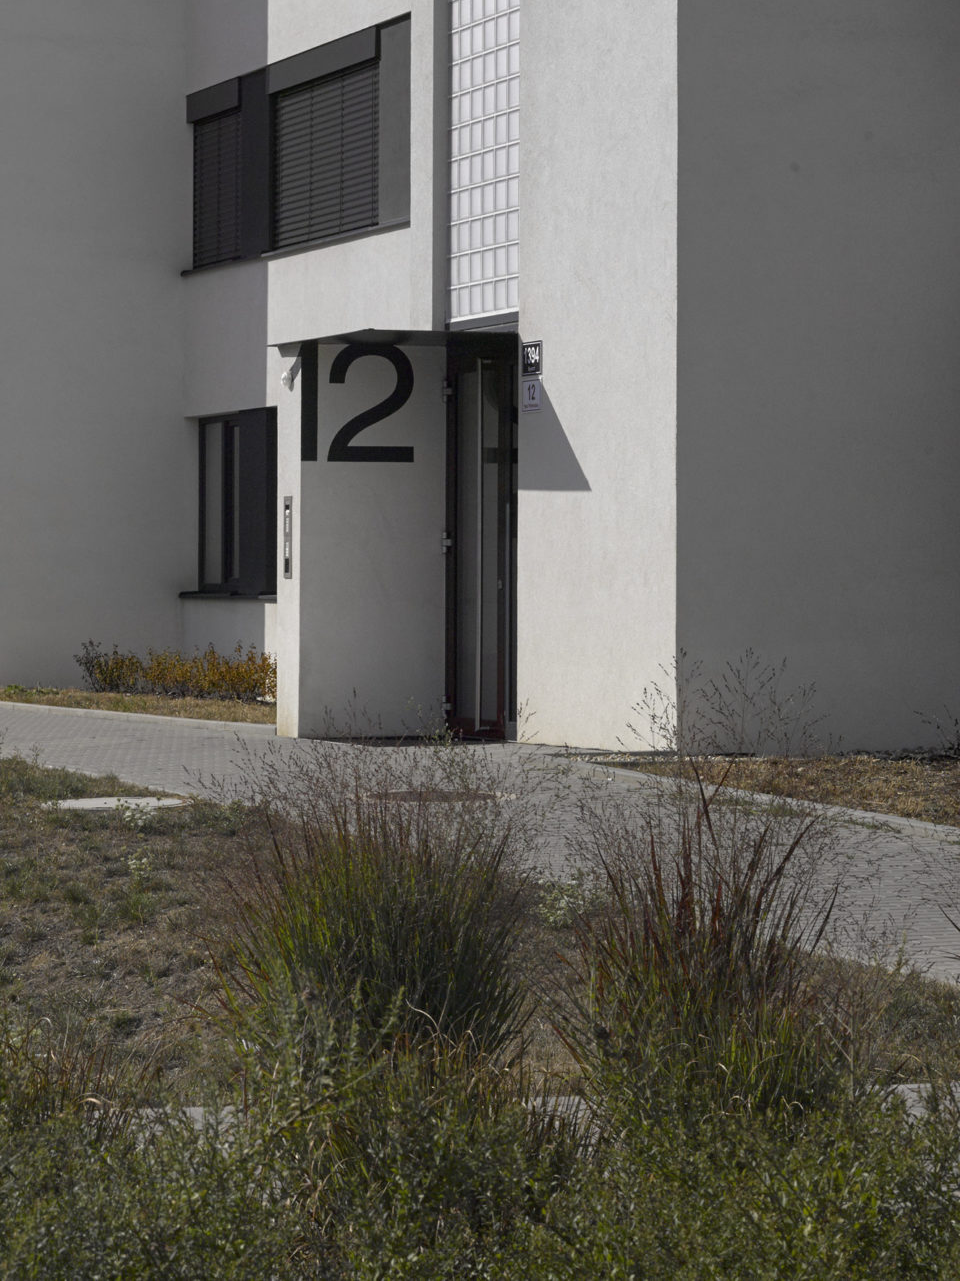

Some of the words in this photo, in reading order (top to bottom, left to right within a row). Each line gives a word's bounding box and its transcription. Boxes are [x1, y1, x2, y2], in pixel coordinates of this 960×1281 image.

[524, 346, 540, 364] 1394
[300, 340, 414, 462] 12
[527, 383, 536, 401] 12
